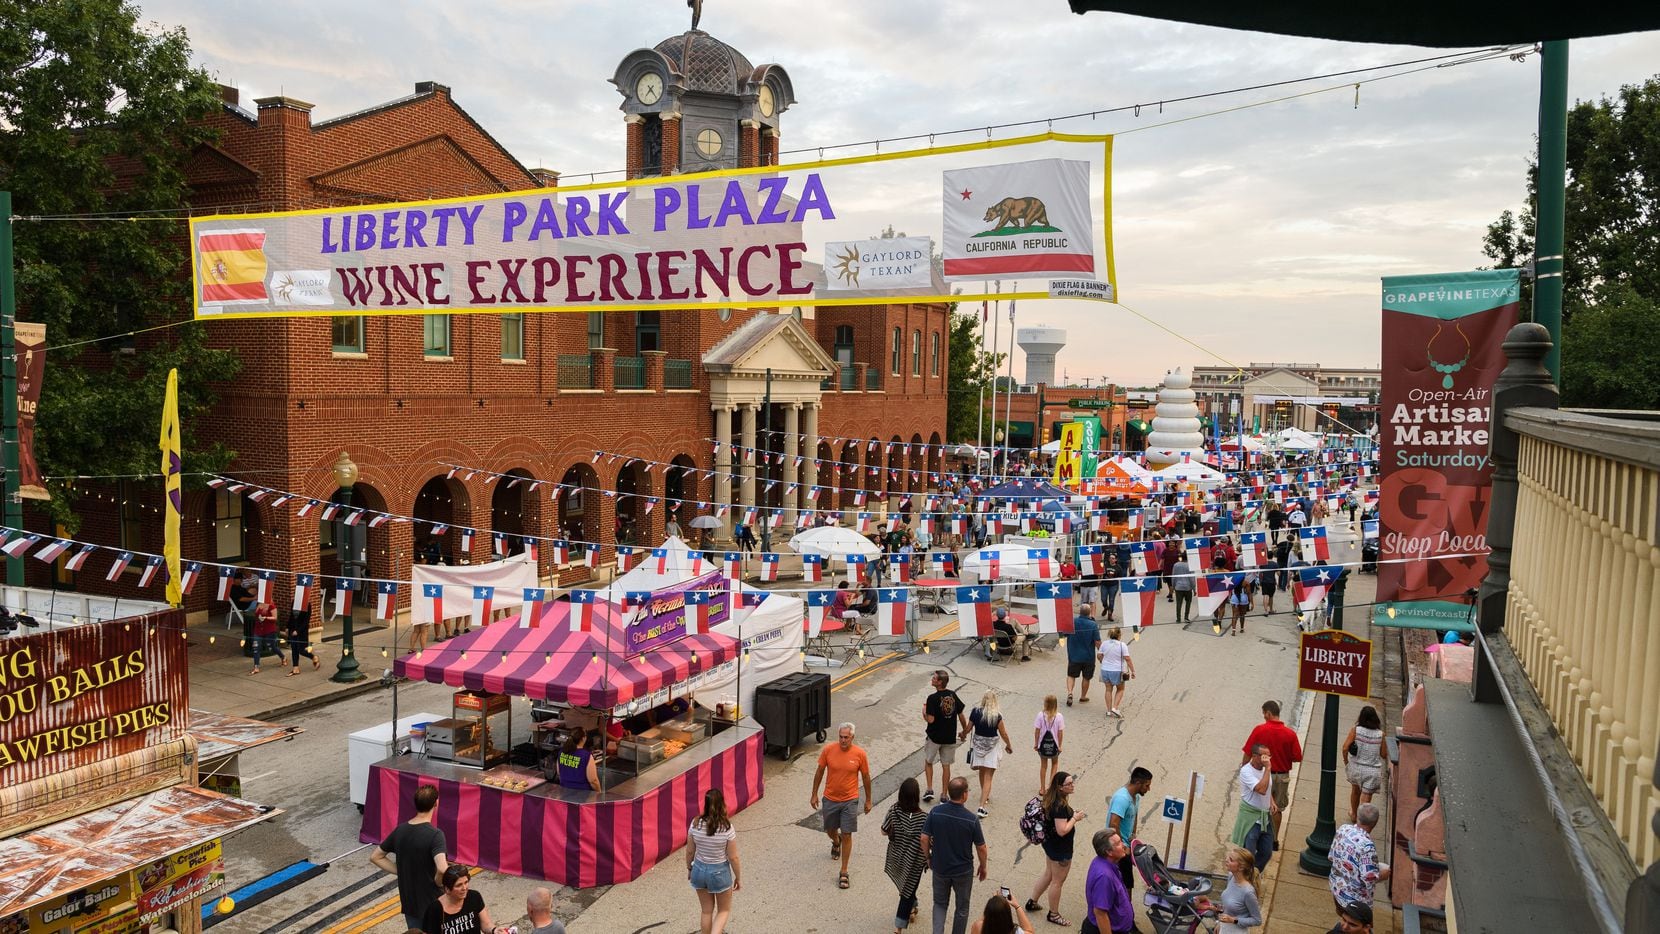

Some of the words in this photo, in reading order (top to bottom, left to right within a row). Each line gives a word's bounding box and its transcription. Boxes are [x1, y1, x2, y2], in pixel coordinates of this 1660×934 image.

[320, 204, 484, 254] LIBERTY
[502, 191, 631, 243] PARK
[653, 173, 836, 232] PLAZA
[862, 250, 922, 263] GAYLORD
[966, 240, 1017, 253] CALIFORNIA
[1023, 238, 1068, 249] REPUBLIC
[335, 262, 450, 307] WINE
[466, 242, 814, 304] EXPERIENCE
[1052, 281, 1066, 289] DIXIE
[1067, 281, 1080, 290] FLAG
[1057, 289, 1103, 299] dixieflag.com
[1408, 387, 1489, 404] Open-Air
[1393, 425, 1489, 446] Marke
[1059, 430, 1074, 480] ATM
[1382, 532, 1432, 561] Shop
[1435, 530, 1490, 552] Loca
[1304, 646, 1366, 668] LIBERTY
[47, 648, 145, 704] BALLS
[1314, 668, 1353, 687] PARK
[113, 702, 170, 737] PIES
[560, 757, 579, 768] WURST
[177, 841, 216, 864] Crawfish
[43, 901, 80, 923] Gator
[84, 886, 120, 907] Balls
[139, 878, 224, 926] Watermelonade
[444, 918, 475, 934] COFFEE
